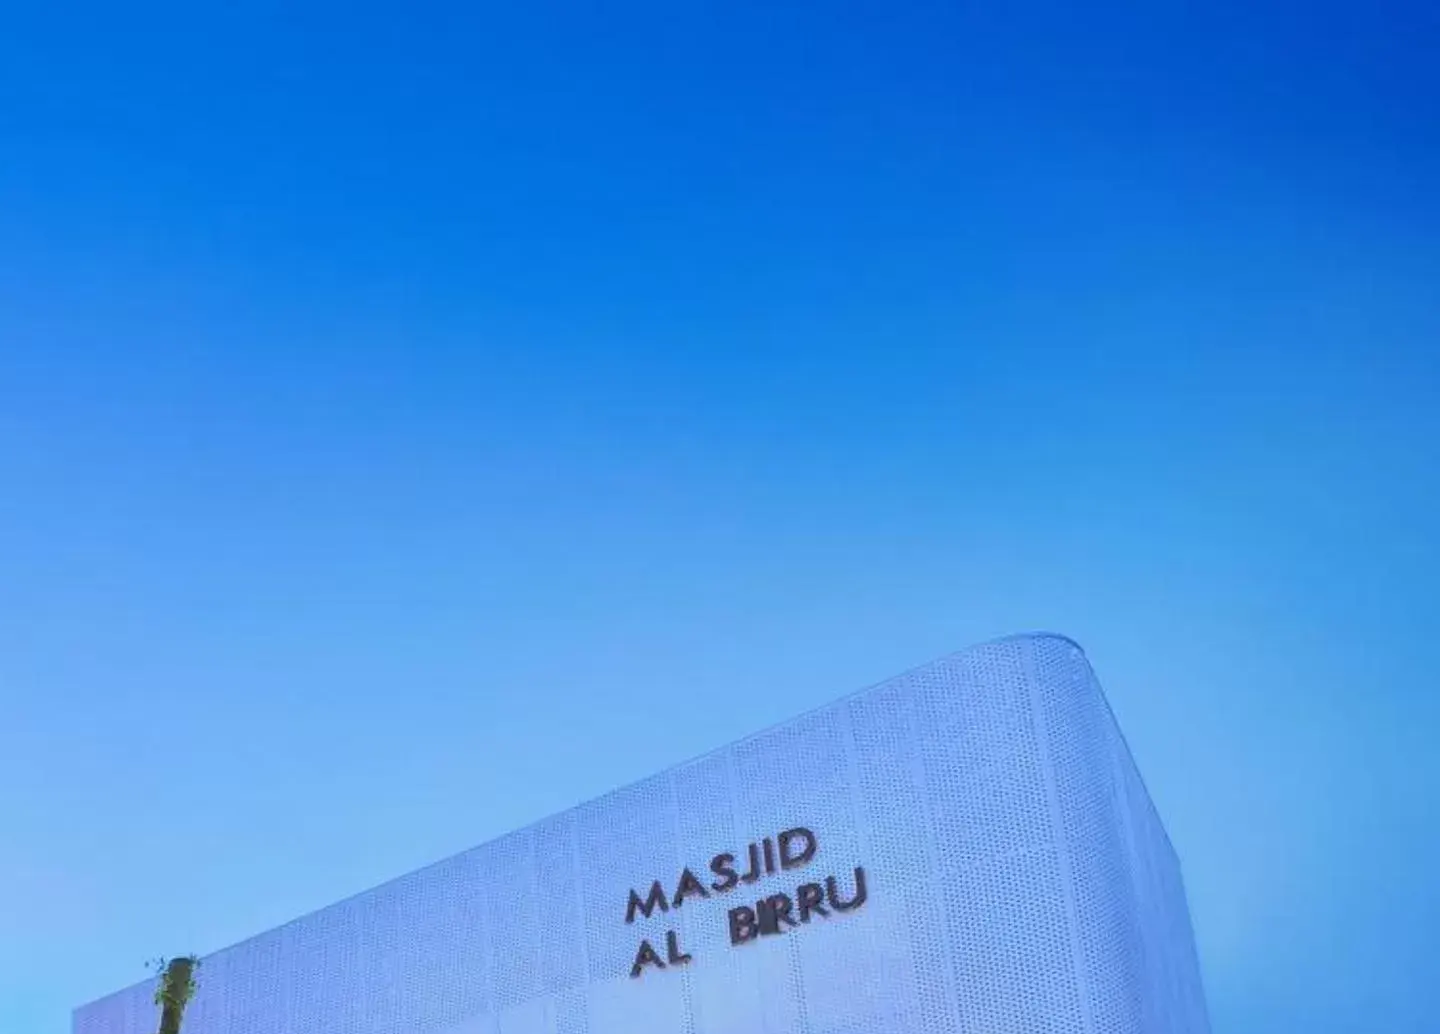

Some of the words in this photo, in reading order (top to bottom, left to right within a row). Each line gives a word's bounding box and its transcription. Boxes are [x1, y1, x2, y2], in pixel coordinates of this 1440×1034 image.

[625, 827, 817, 924] MASJID
[630, 930, 692, 979] AL
[728, 867, 868, 947] BIRRU
